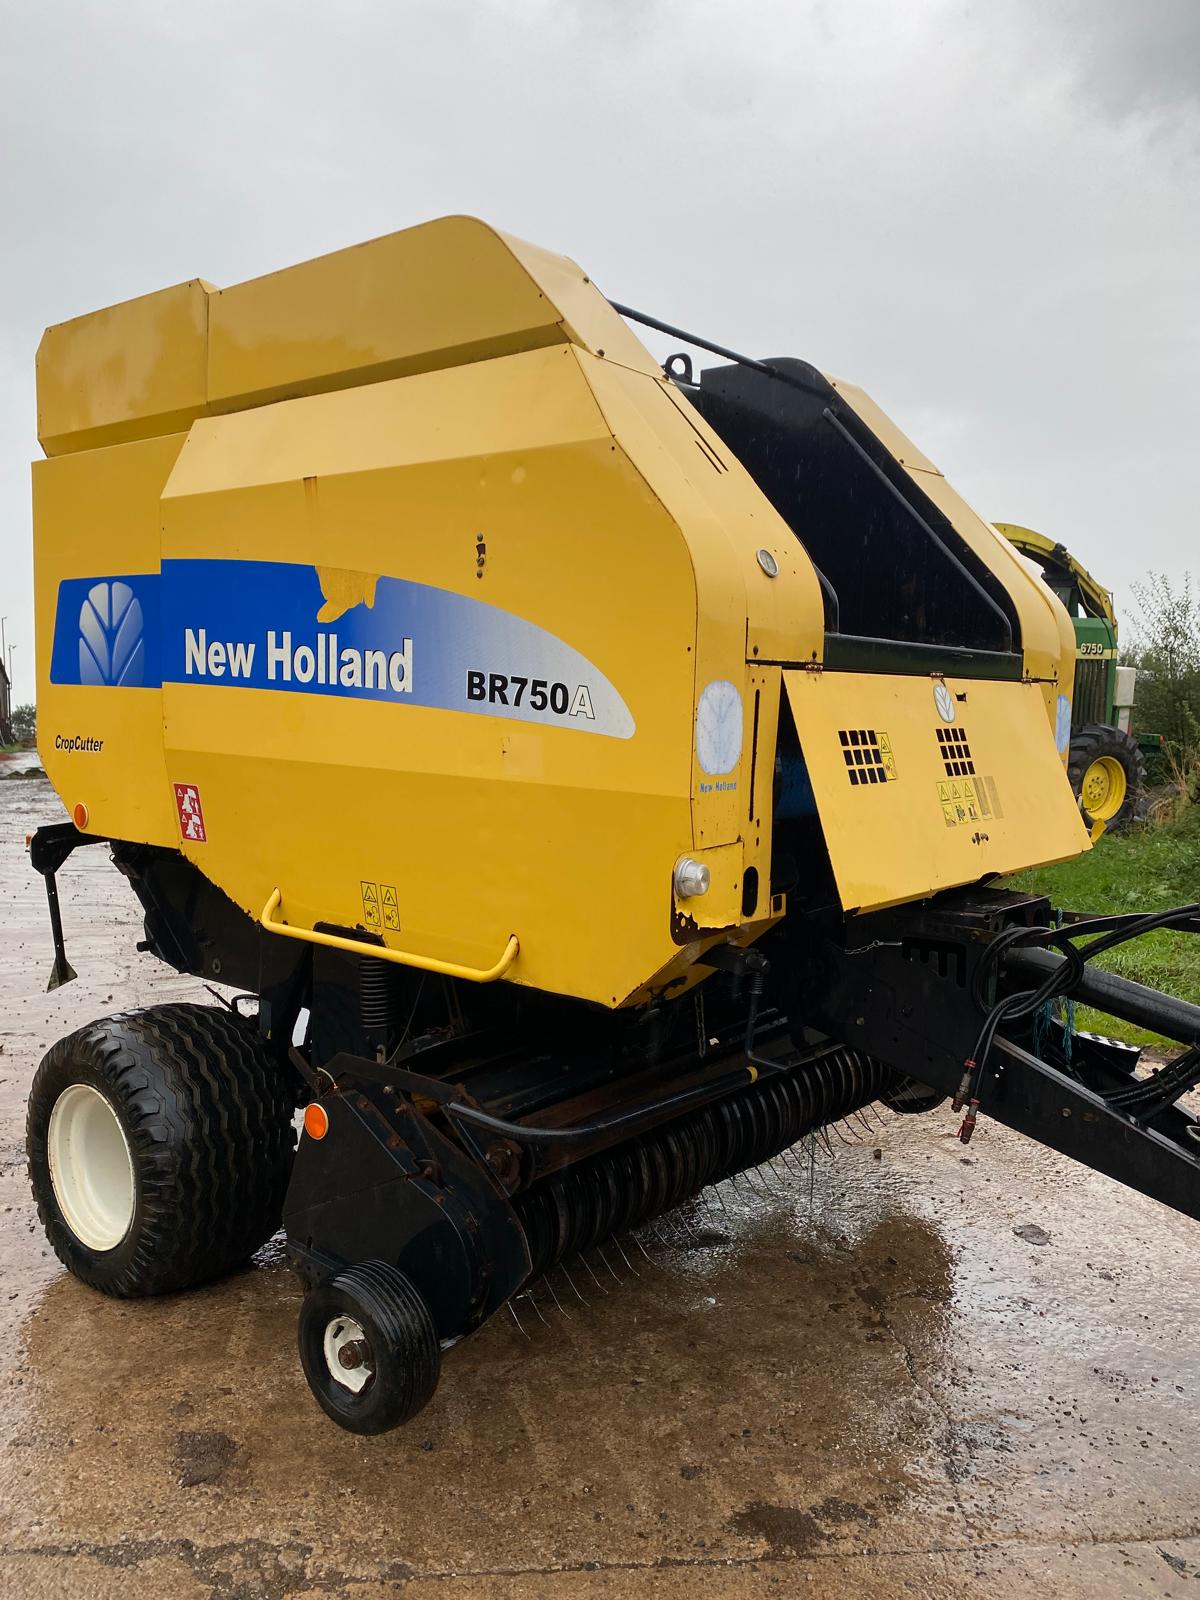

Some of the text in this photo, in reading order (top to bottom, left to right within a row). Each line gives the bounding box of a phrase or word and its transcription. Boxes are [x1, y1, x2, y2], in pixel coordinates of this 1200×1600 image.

[184, 628, 413, 693] New Holland
[1080, 642, 1104, 655] 6750
[467, 670, 596, 720] BR750A
[55, 734, 104, 754] CropCutter
